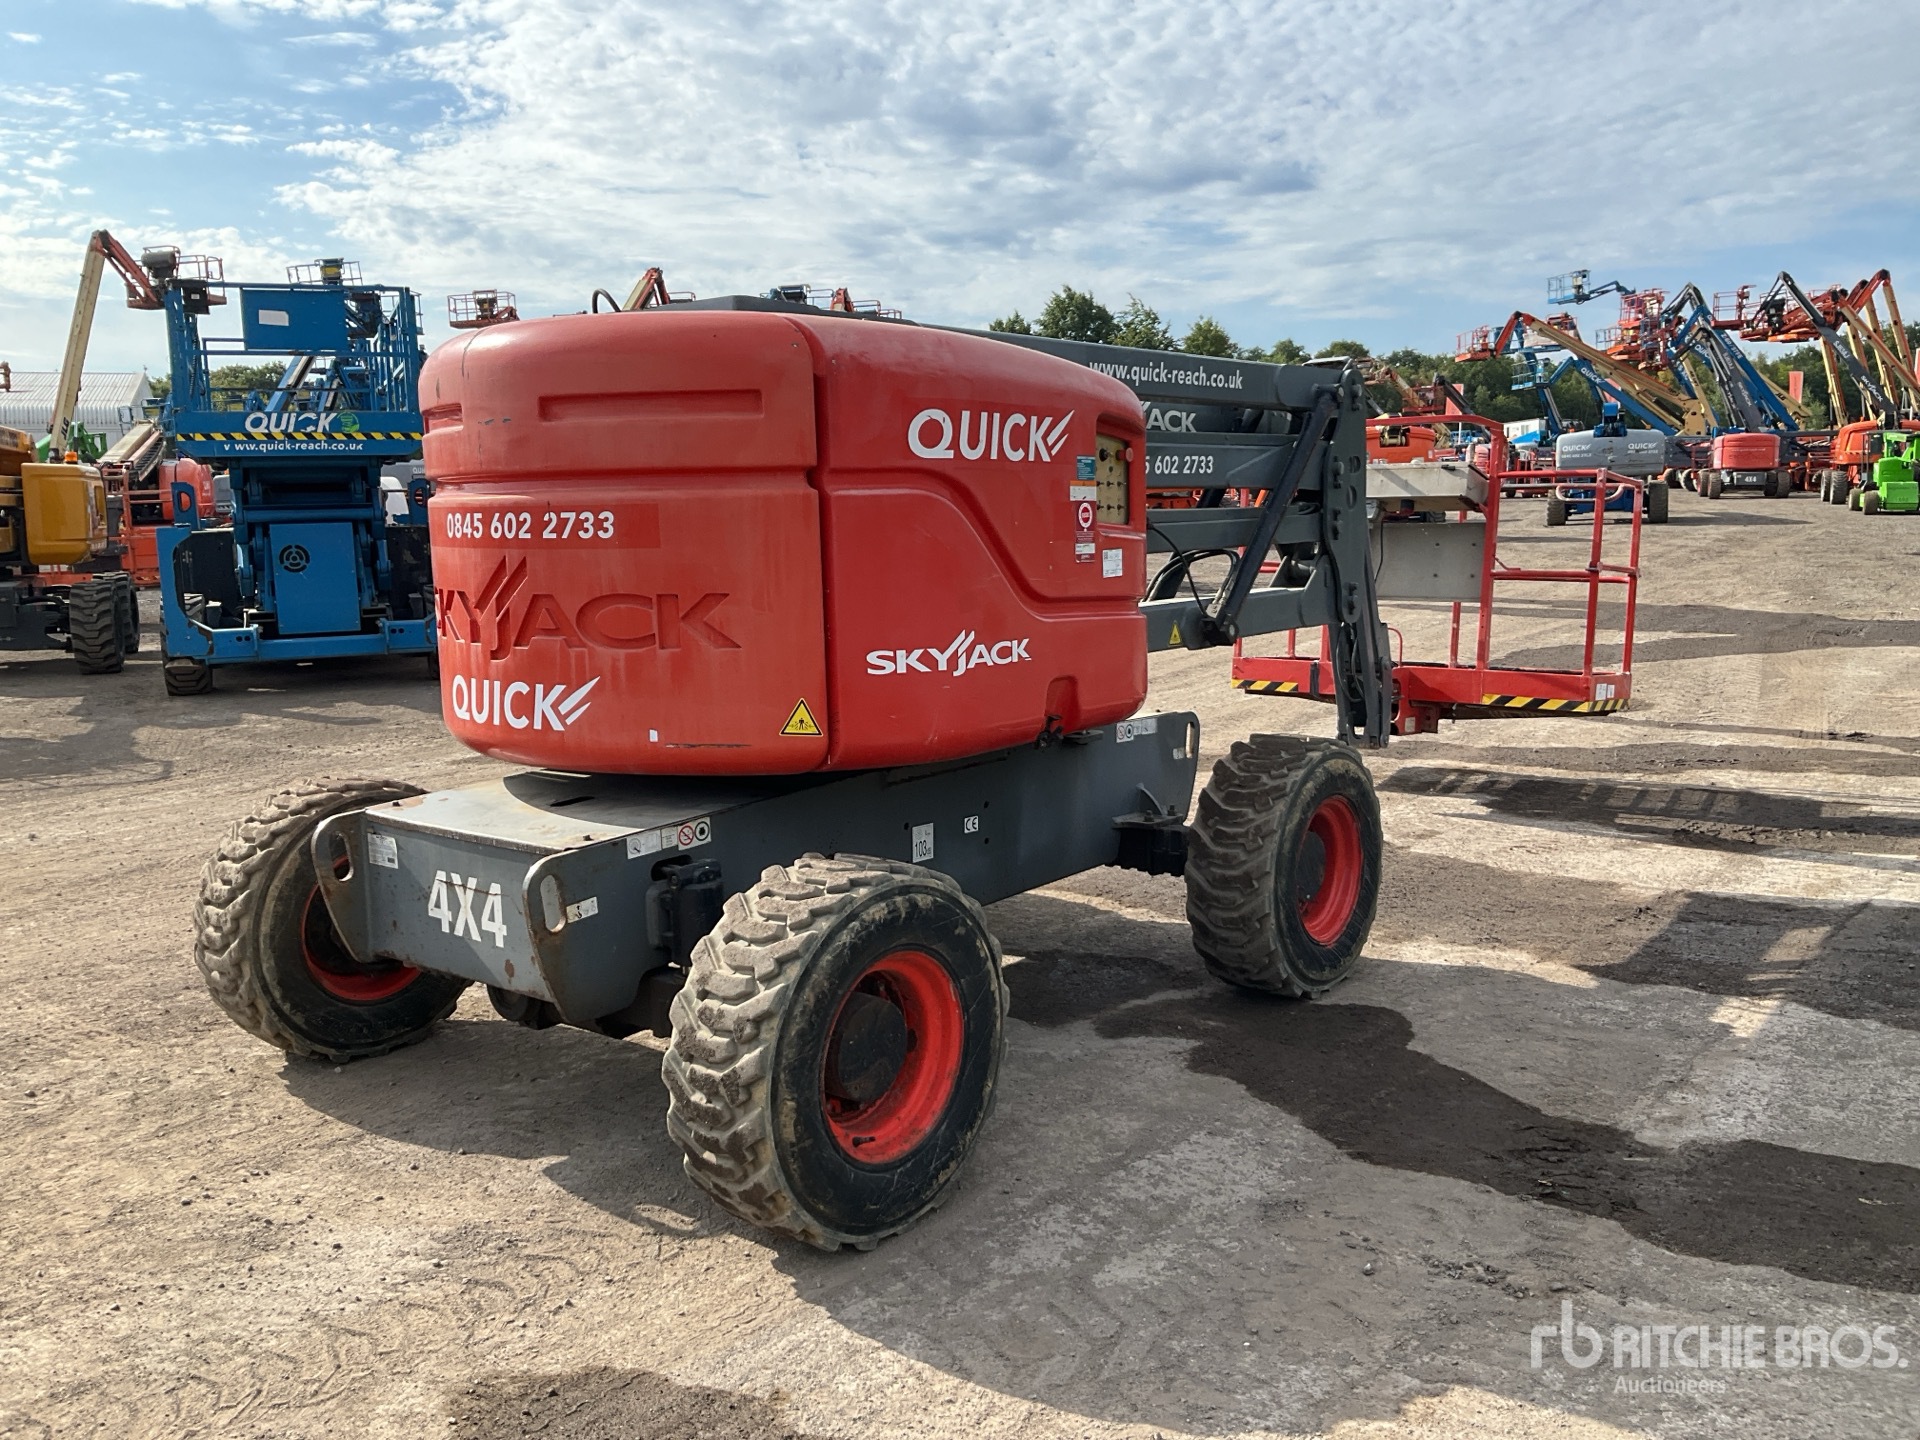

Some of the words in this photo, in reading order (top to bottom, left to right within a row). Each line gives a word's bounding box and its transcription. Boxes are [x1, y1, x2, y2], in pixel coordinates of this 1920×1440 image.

[1580, 367, 1601, 384] QUICK
[1860, 375, 1884, 403] SKYJACK
[60, 416, 70, 441] JLG
[244, 411, 337, 433] QUICK
[908, 408, 1054, 463] QUICK
[1154, 455, 1179, 474] 602
[1183, 455, 1214, 474] 2733
[446, 512, 483, 539] 0845
[490, 512, 531, 539] 602
[542, 511, 614, 539] 2733
[866, 629, 1032, 677] SKYJACK
[452, 674, 566, 732] QUICK
[428, 870, 507, 948] 4X4
